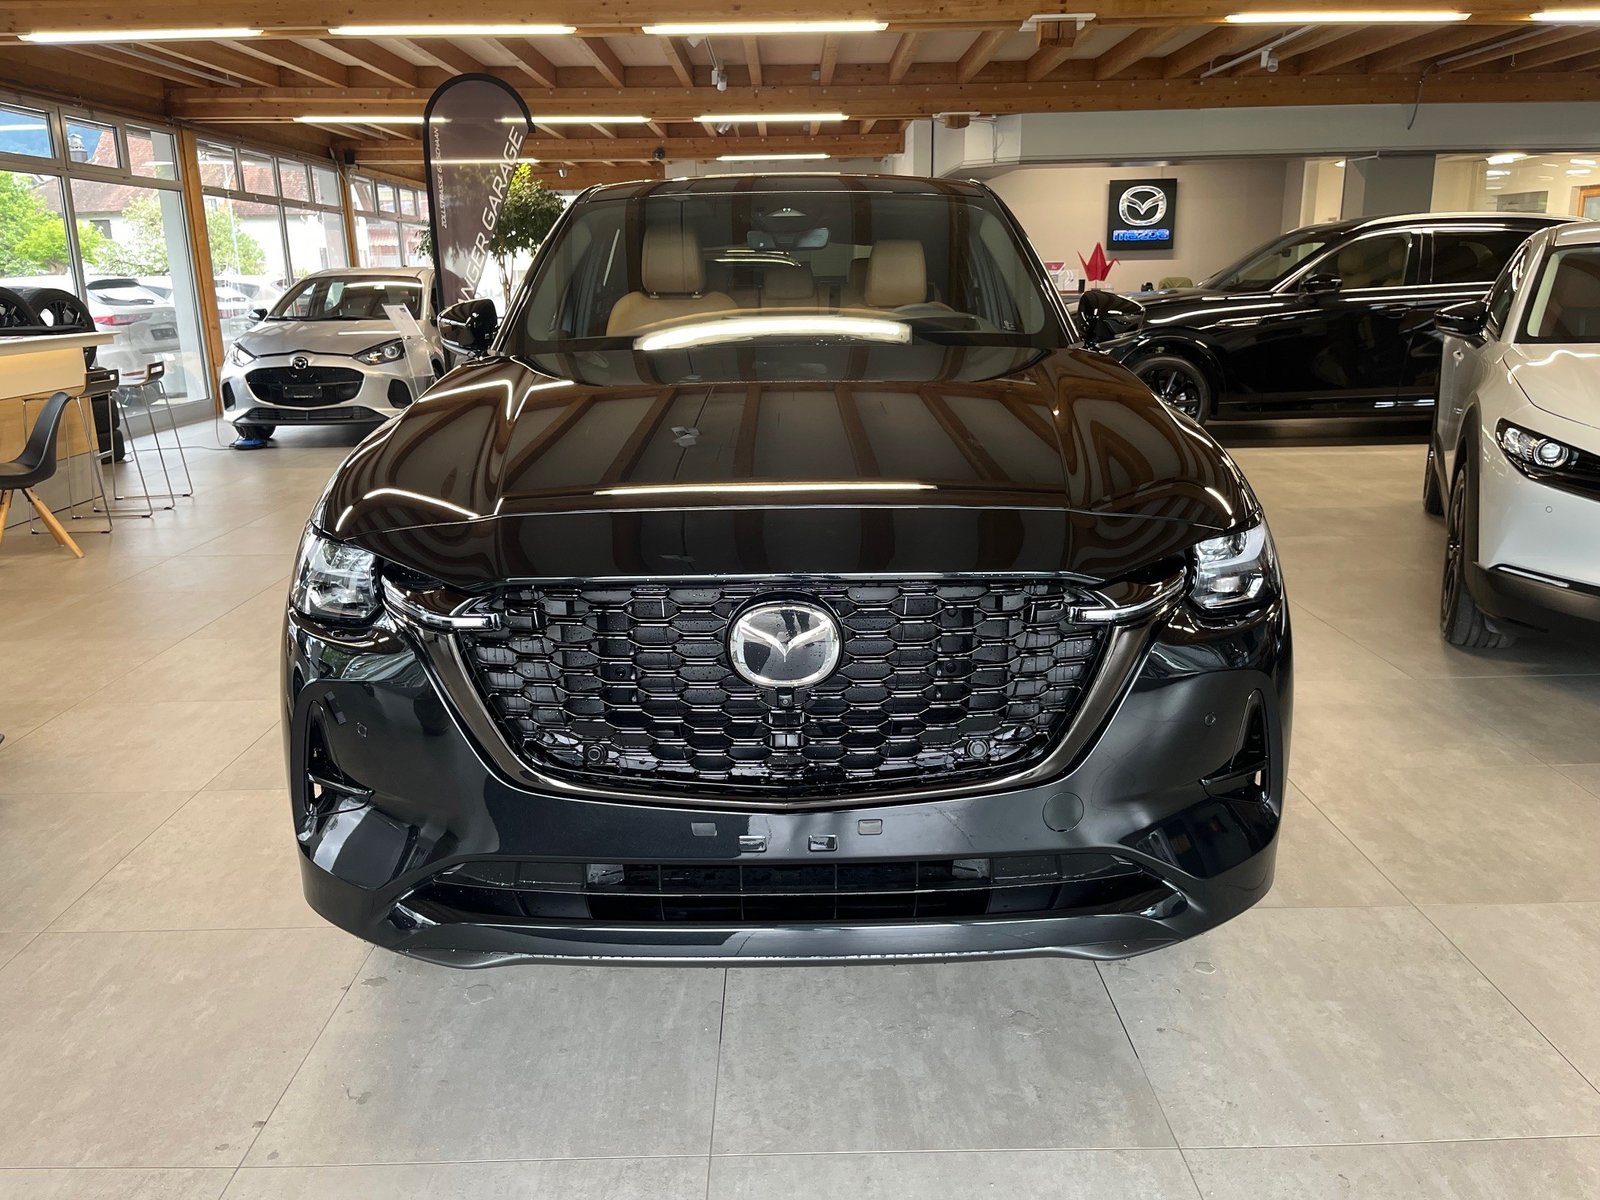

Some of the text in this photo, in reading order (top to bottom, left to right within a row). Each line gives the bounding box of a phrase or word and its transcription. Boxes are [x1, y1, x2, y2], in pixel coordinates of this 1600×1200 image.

[433, 127, 442, 161] SCHAAN
[438, 173, 447, 229] ZOLLSTRASSE
[458, 126, 523, 303] NGER GARAGE
[1113, 229, 1169, 241] mazda
